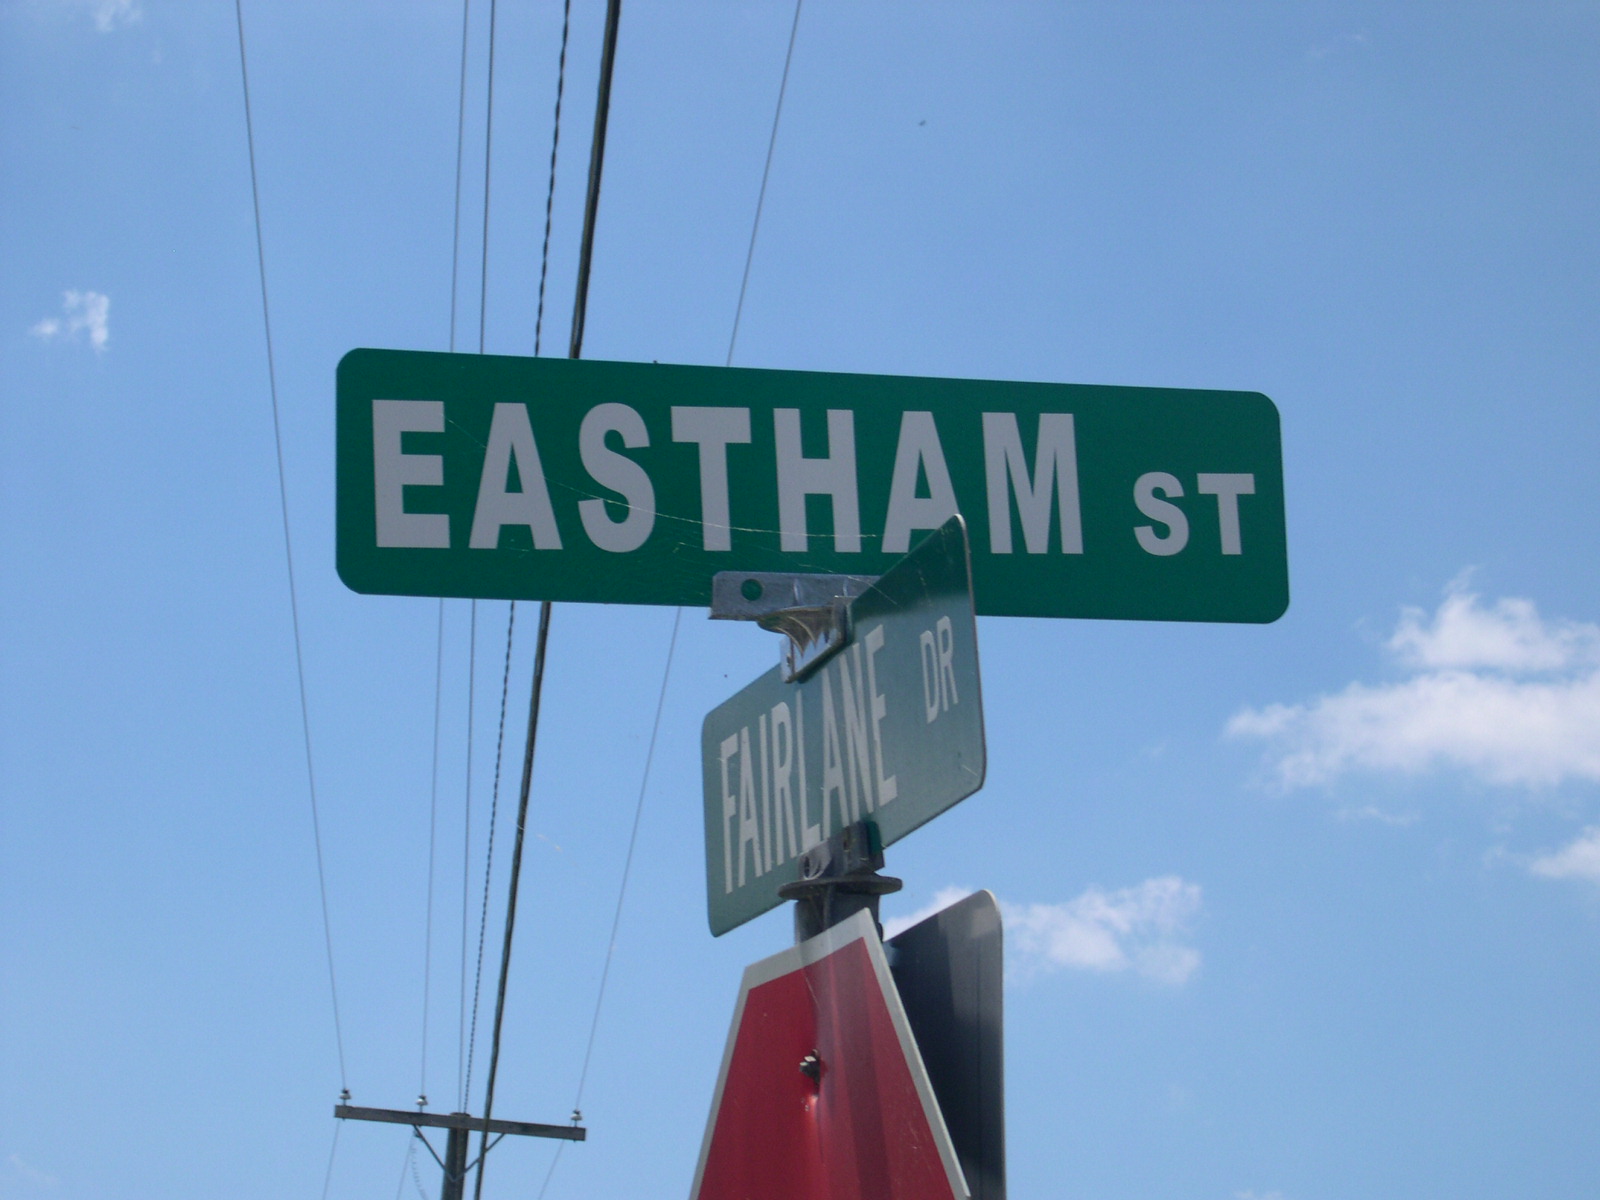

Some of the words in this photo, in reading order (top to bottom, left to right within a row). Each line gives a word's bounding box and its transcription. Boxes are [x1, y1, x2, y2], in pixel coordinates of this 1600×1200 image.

[372, 399, 1083, 556] EASTHAM
[1134, 471, 1255, 557] ST
[719, 624, 899, 894] FAIRLANE
[920, 615, 959, 725] DR
